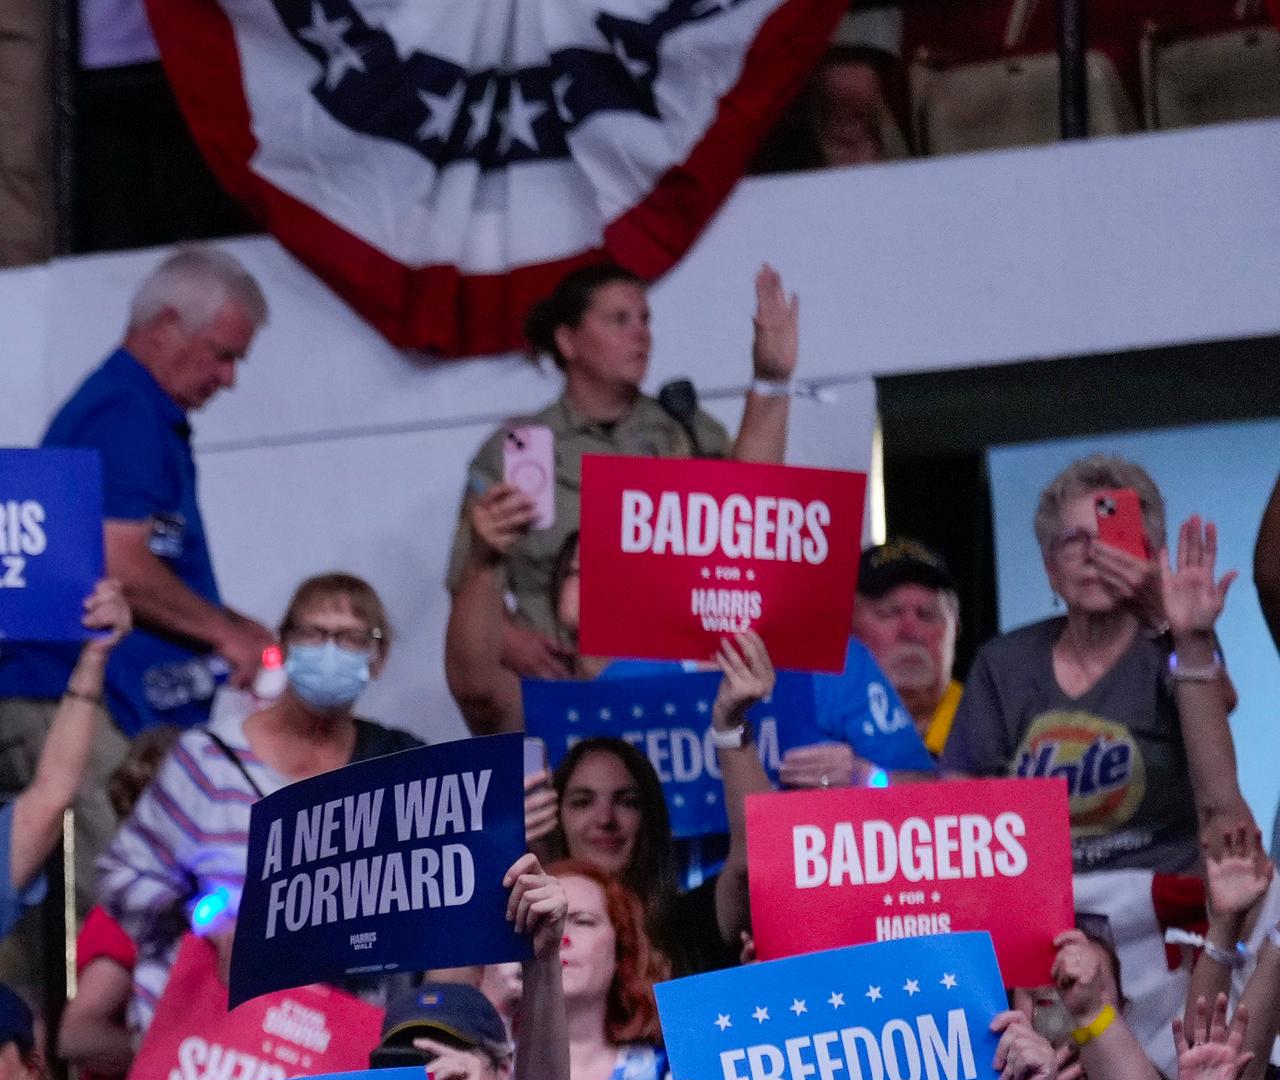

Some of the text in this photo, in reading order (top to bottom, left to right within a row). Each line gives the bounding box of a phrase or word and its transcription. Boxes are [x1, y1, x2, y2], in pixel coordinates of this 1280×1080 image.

[620, 490, 831, 566] BADGERS
[715, 567, 741, 580] FOR
[691, 589, 762, 620] HARRIS
[260, 769, 493, 882] A NEW WAY
[791, 812, 1028, 889] BADGERS
[265, 842, 476, 940] FORWARD
[898, 892, 926, 906] FOR
[875, 914, 952, 942] HARRIS
